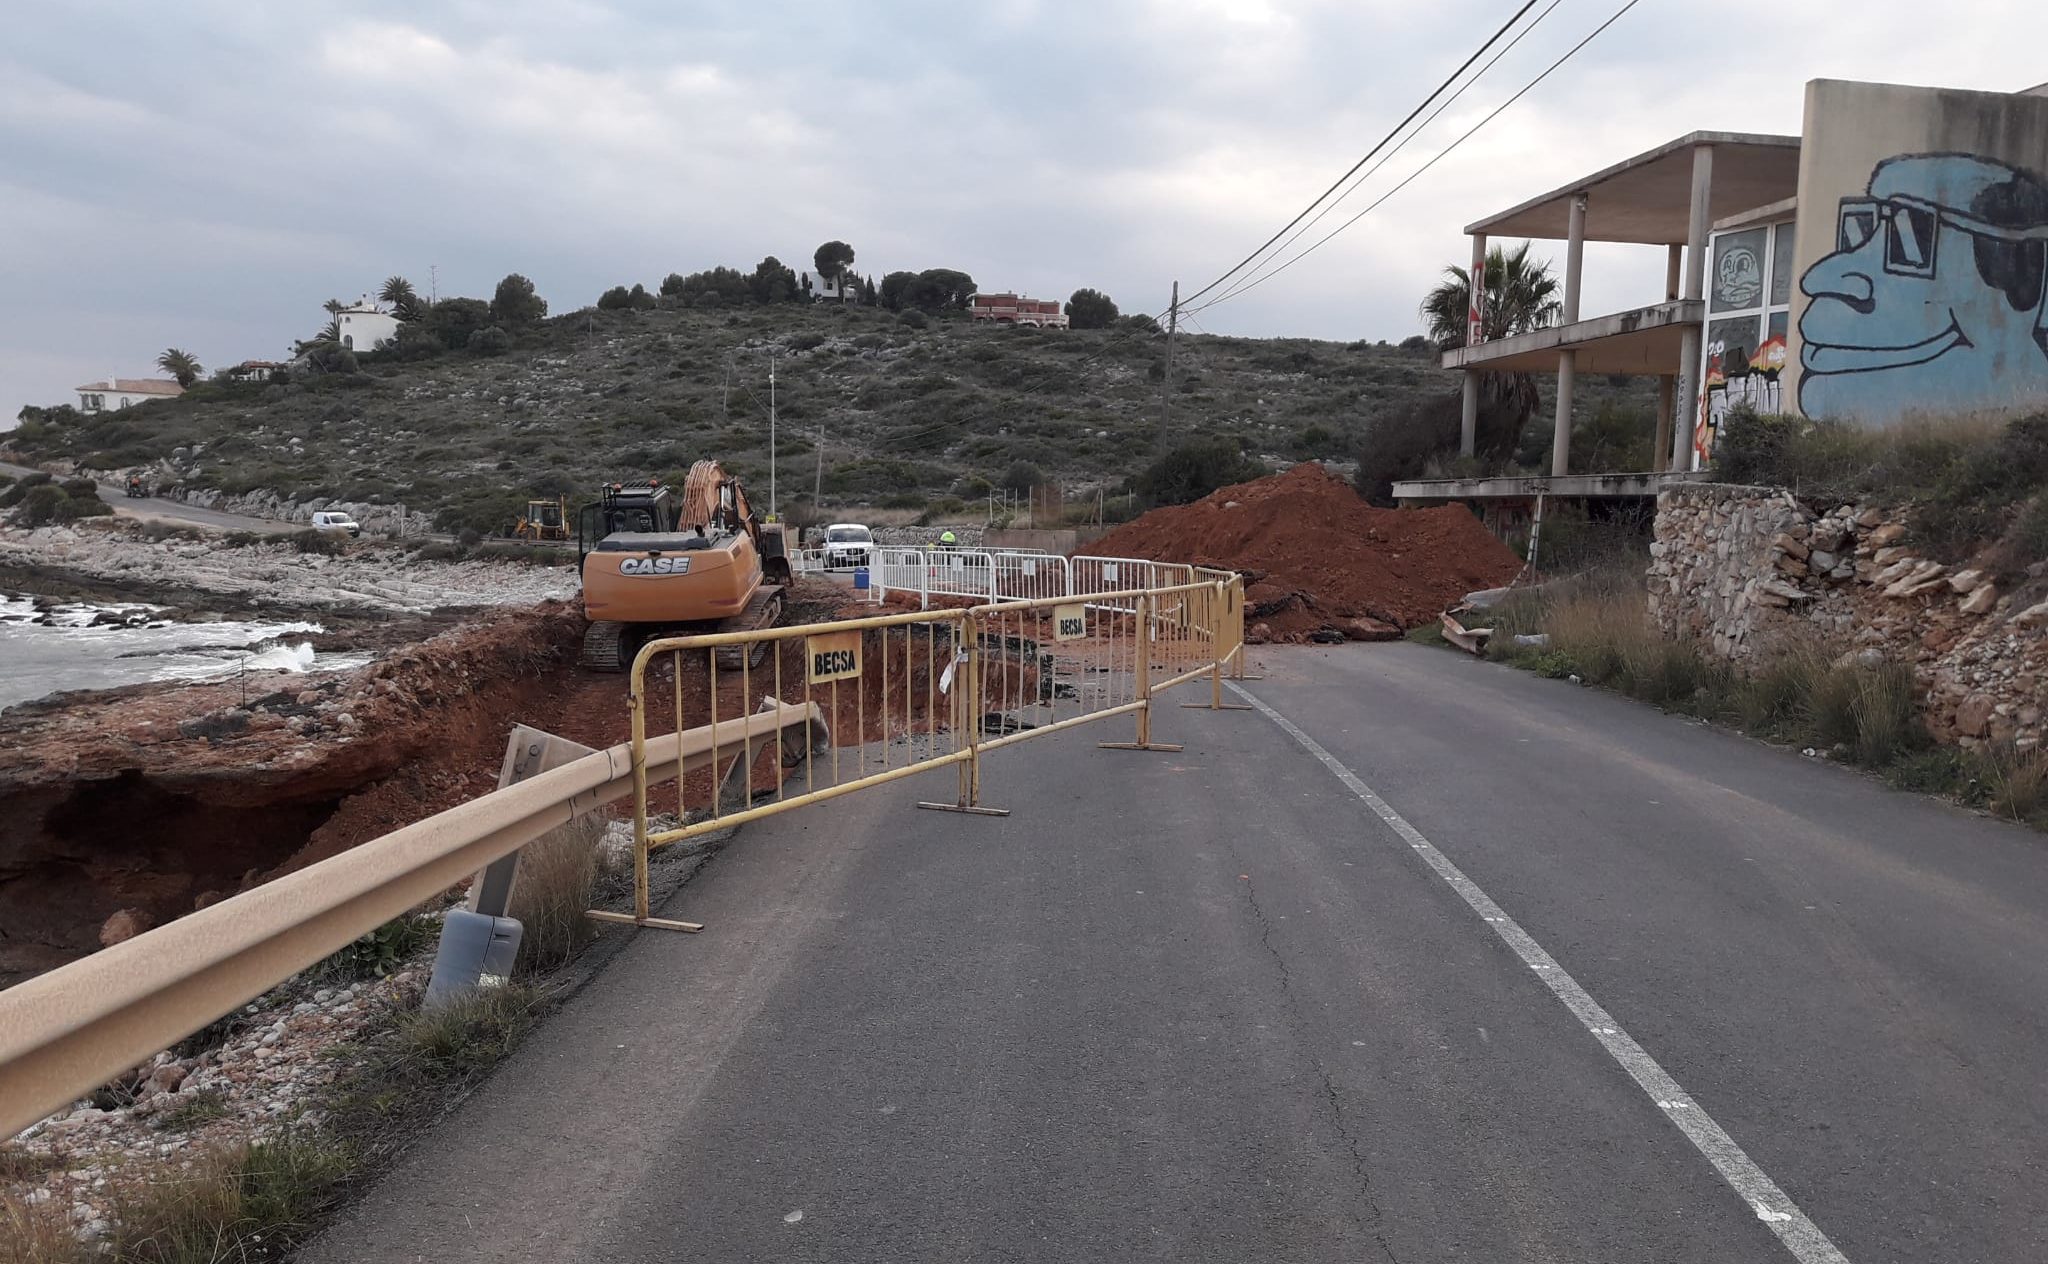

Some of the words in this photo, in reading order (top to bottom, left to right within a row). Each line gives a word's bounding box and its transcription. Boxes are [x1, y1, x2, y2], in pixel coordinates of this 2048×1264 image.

[620, 557, 690, 575] CASE
[1060, 617, 1083, 636] BECSA
[814, 650, 856, 676] BECSA
